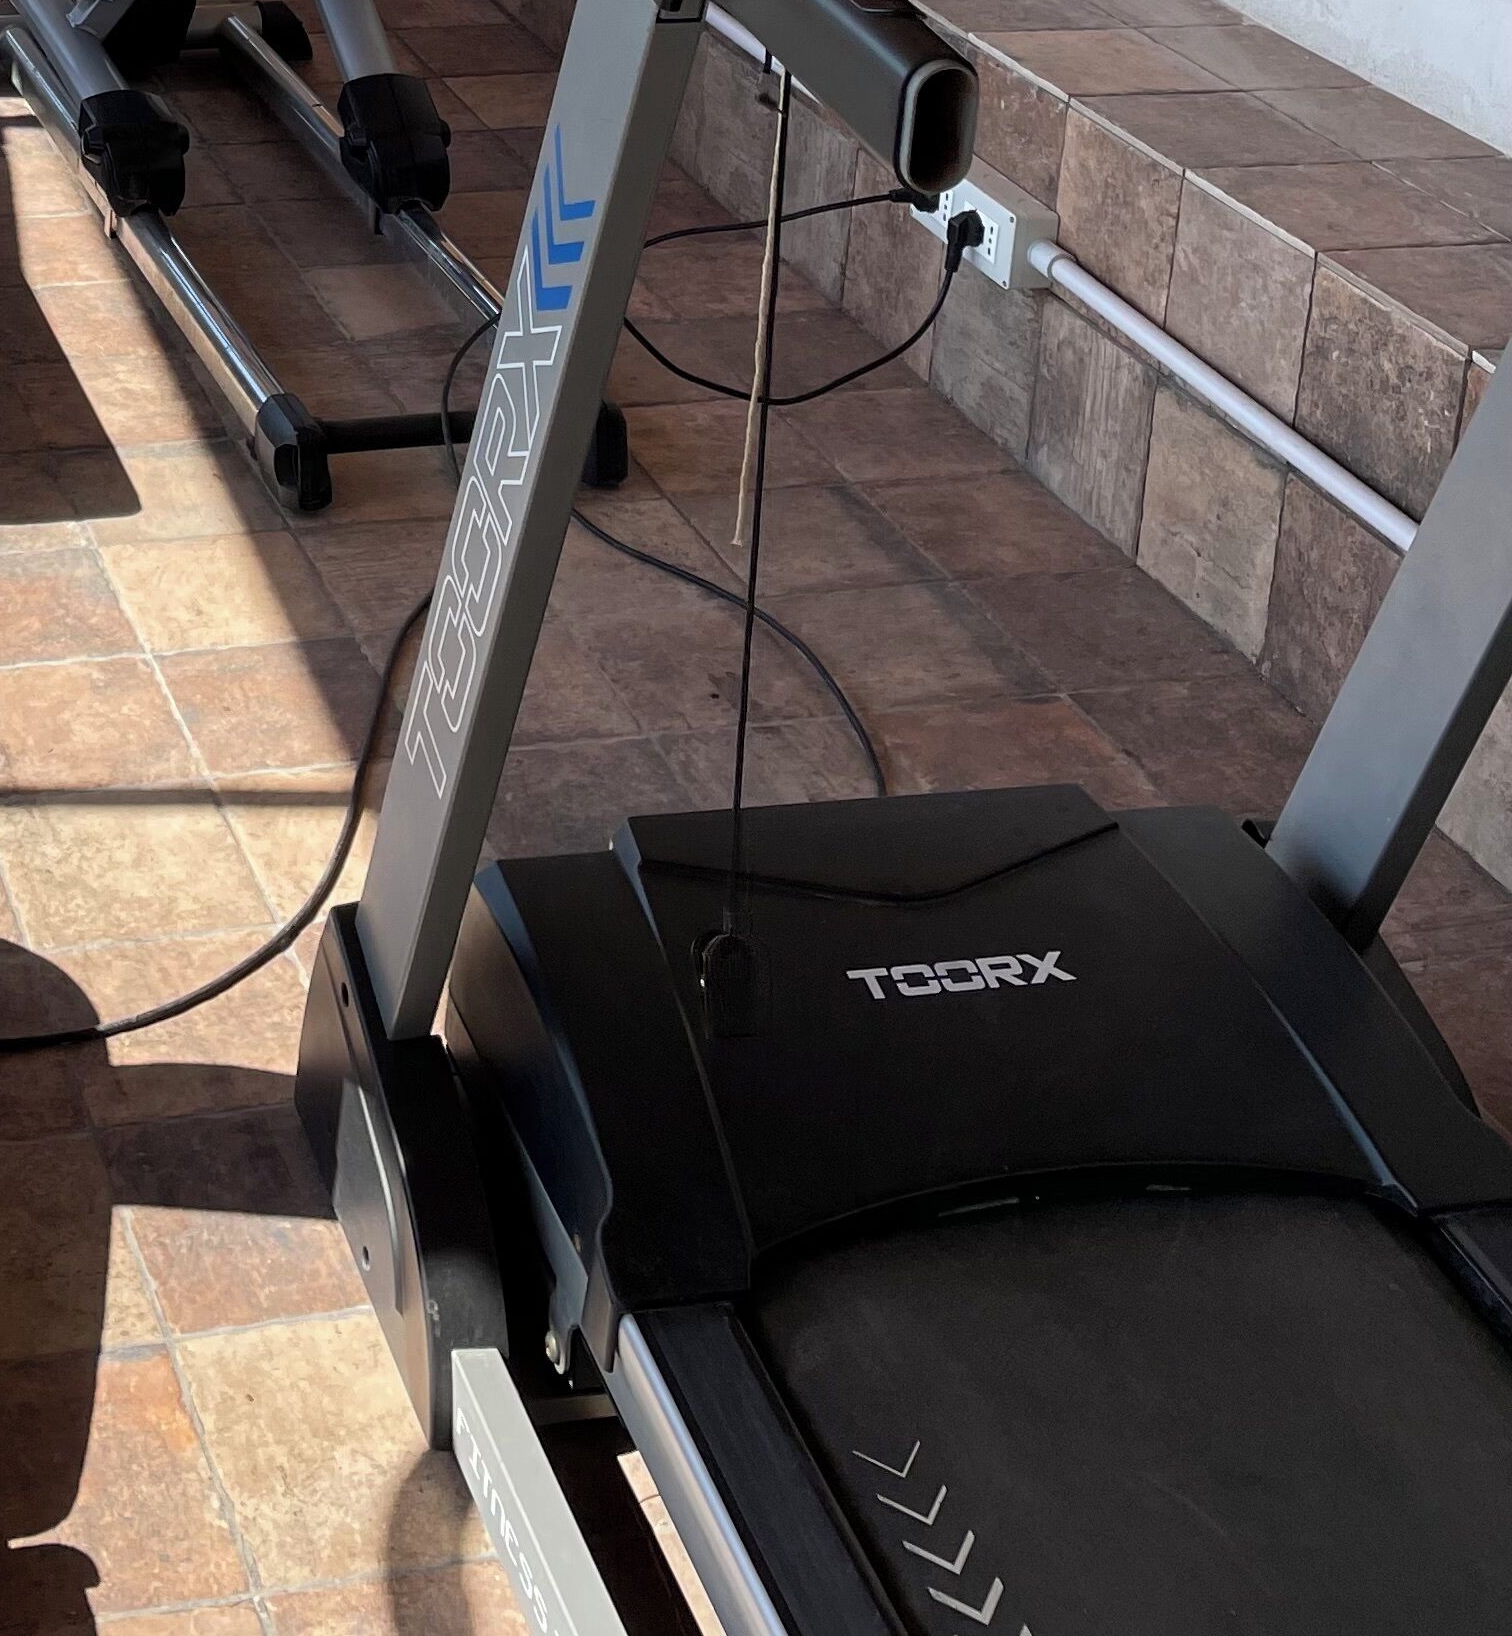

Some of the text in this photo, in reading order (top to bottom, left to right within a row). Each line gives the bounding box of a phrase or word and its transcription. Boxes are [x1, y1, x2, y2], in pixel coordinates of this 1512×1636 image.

[404, 244, 562, 800] TOORX
[846, 950, 1078, 1000] TOORX
[455, 1406, 549, 1634] FITNESS
